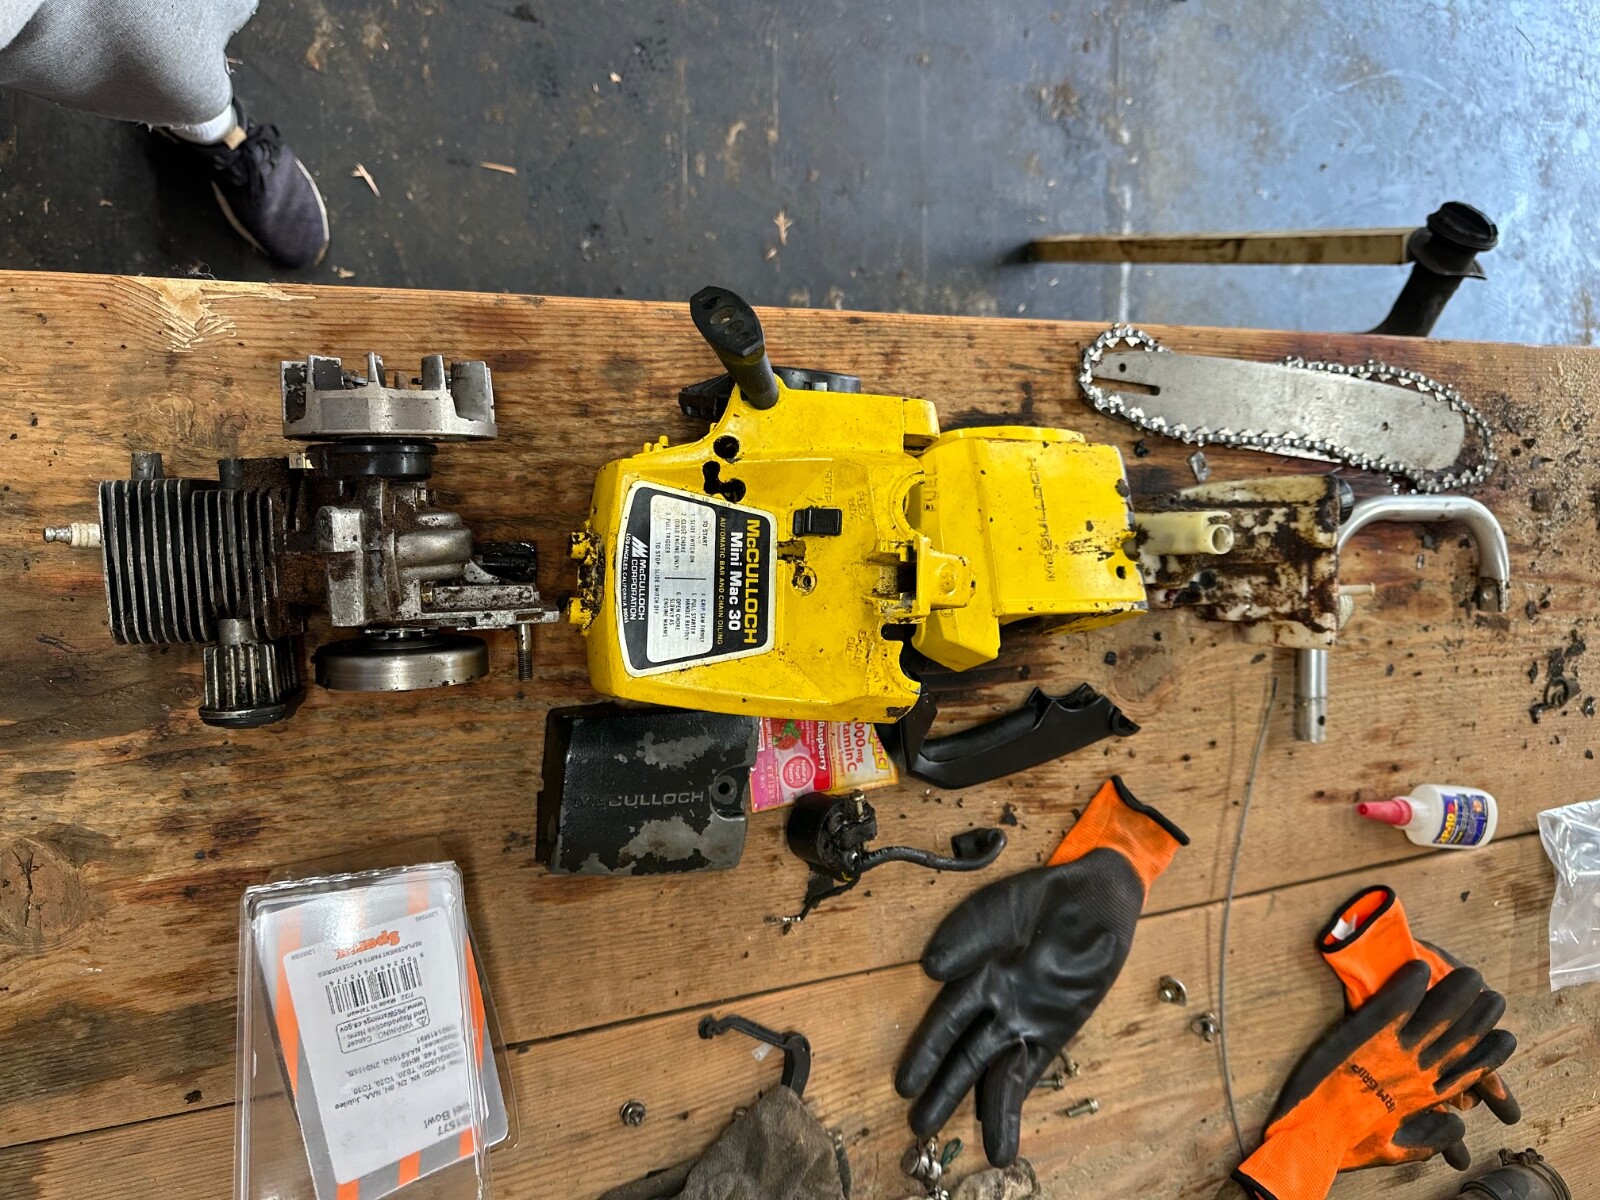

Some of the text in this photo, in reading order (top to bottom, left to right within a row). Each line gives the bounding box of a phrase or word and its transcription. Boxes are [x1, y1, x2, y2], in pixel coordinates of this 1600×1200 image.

[630, 559, 638, 620] CORPORATION
[638, 559, 646, 620] McCULLOCH
[729, 532, 743, 630] Mini Mac 30
[744, 520, 760, 644] McCULLOCH
[816, 722, 827, 771] Raspberry
[843, 722, 857, 772] tamin C
[854, 722, 866, 763] 000 mg
[873, 733, 888, 767] gen-C
[363, 953, 382, 964] PARTS
[382, 940, 422, 958] REPLACEMENT
[317, 961, 358, 978] ACCESSORIES
[371, 1003, 378, 1011] in
[379, 998, 397, 1008] Made
[413, 1009, 426, 1018] and
[346, 1035, 372, 1048] Cancer
[1351, 1064, 1396, 1114] IRM GRIP
[423, 1110, 451, 1129] Bowl
